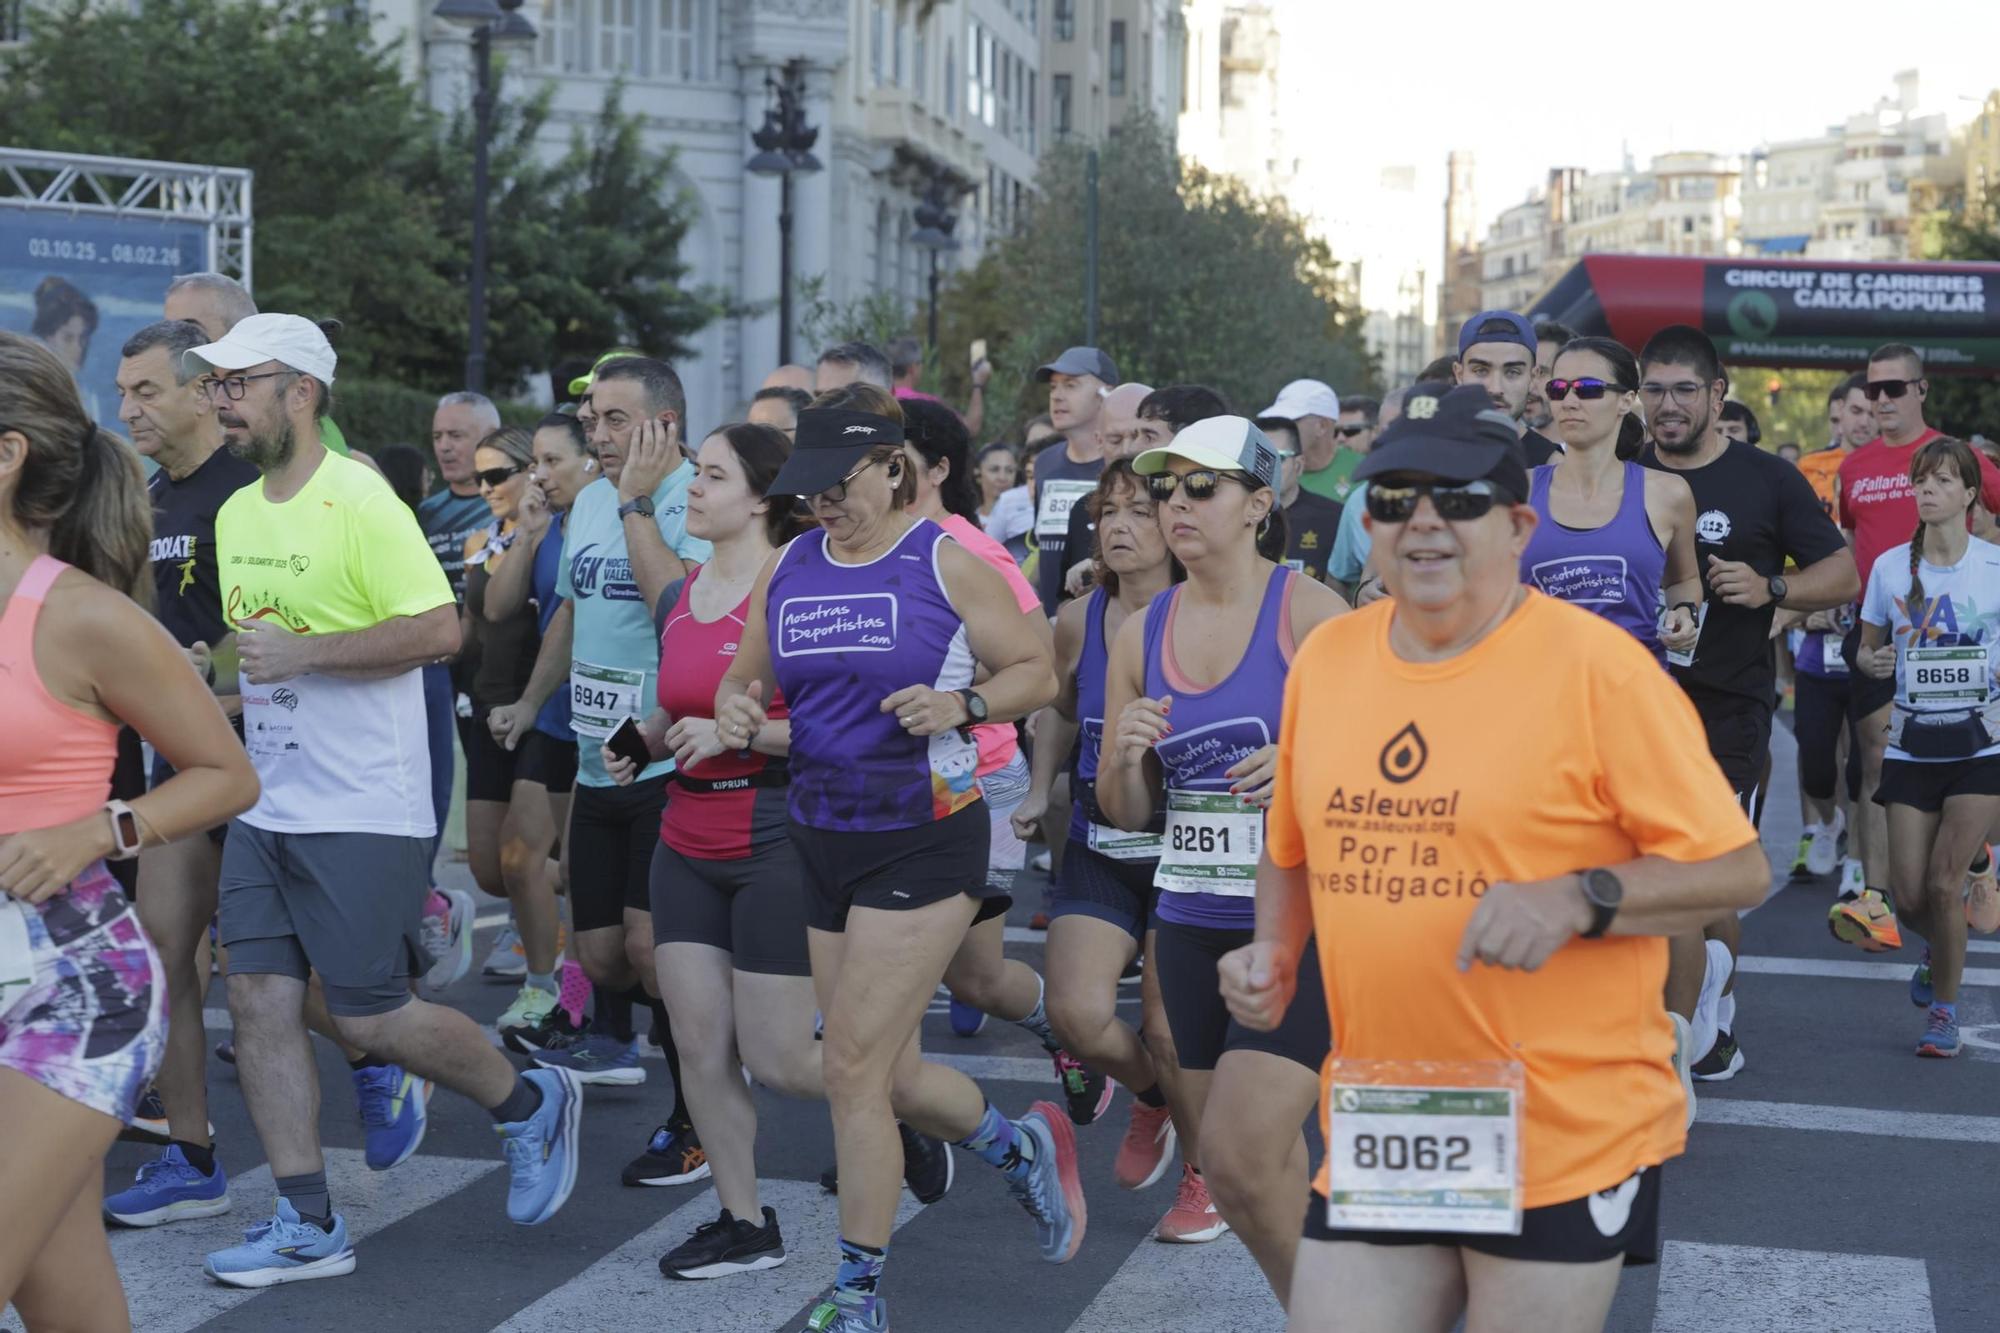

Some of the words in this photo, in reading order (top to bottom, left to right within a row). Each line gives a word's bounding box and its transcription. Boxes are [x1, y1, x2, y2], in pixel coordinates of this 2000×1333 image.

[29, 238, 97, 261] 03.10.25
[1725, 269, 1817, 288] CIRCUIT
[1820, 273, 1852, 290] DE
[1855, 274, 1984, 293] CARRERES
[1857, 490, 1888, 504] equip
[1888, 489, 1903, 499] de
[1601, 588, 1623, 598] .com
[784, 604, 851, 627] nosotras
[788, 614, 887, 643] Deportistas
[858, 633, 891, 645] .com
[1916, 667, 1970, 684] 8658
[574, 684, 619, 711] 6947
[711, 777, 749, 791] KIPRUN
[1326, 786, 1461, 818] Asleuval
[1324, 817, 1456, 837] www.asleuval.org
[1172, 824, 1231, 854] 8261
[1339, 836, 1398, 866] Por
[1410, 840, 1439, 867] la
[1353, 1133, 1472, 1172] 8062
